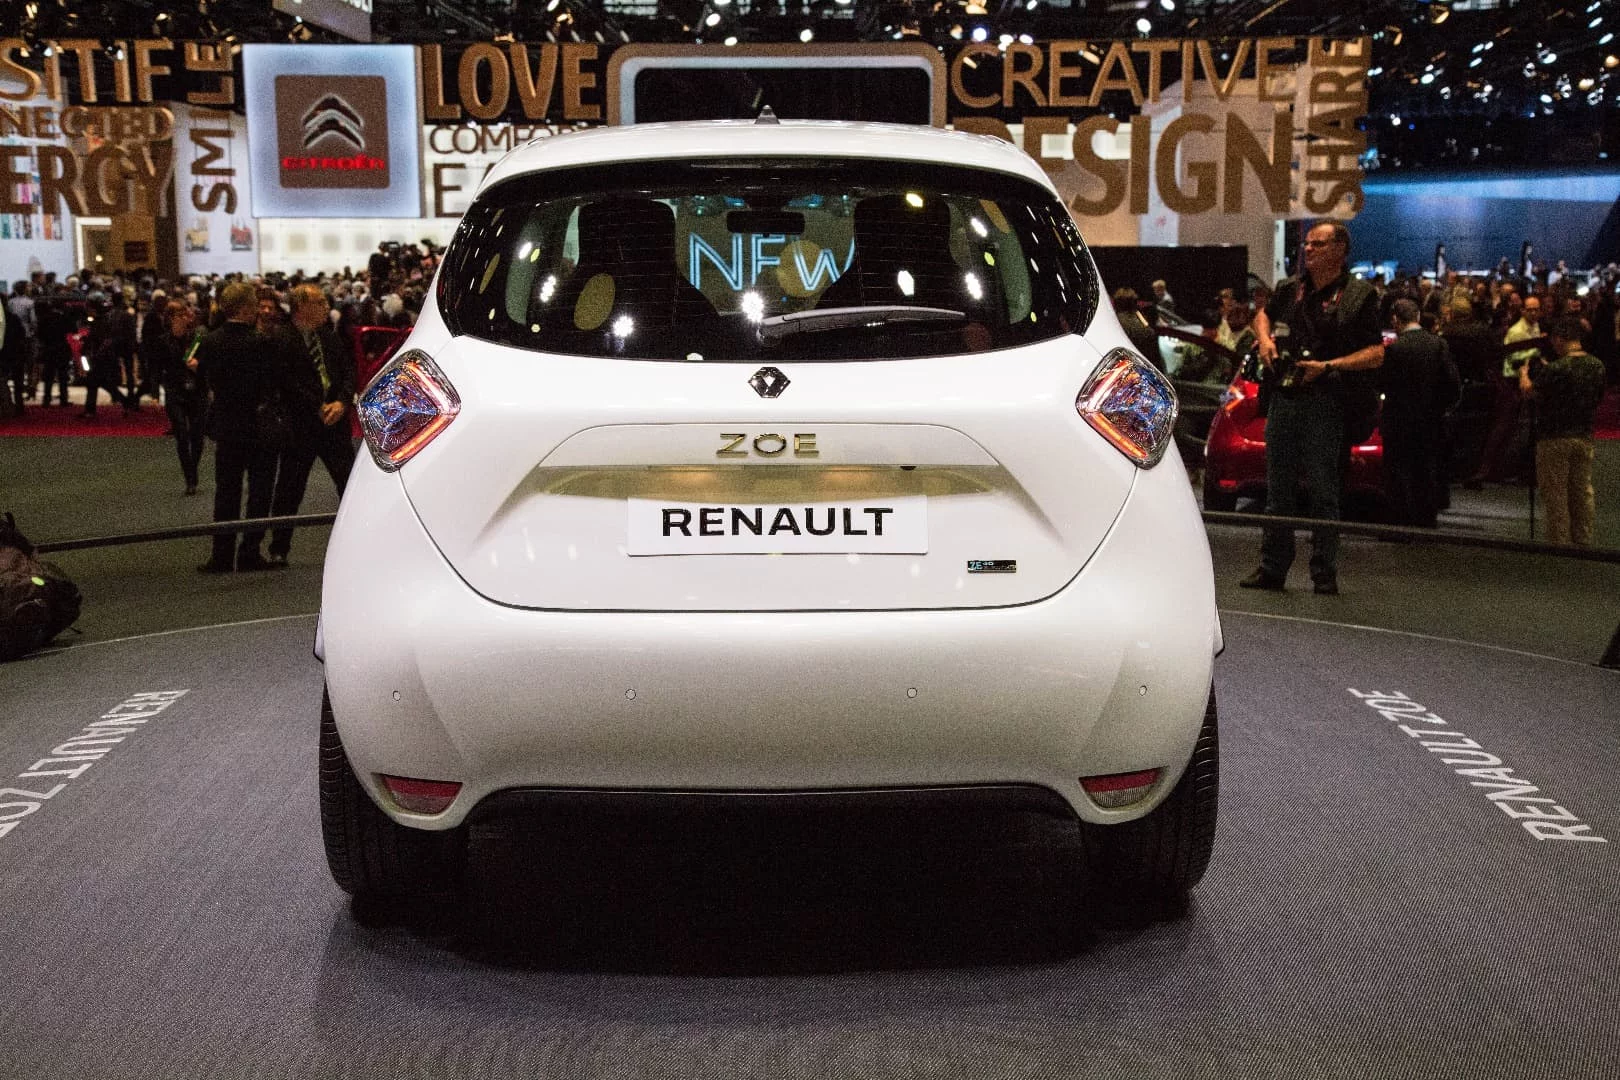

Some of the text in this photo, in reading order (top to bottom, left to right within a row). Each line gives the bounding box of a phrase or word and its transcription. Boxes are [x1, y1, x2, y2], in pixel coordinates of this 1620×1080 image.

[421, 43, 602, 120] LOVE
[951, 38, 1298, 107] CREATIVE
[184, 40, 238, 214] SMILE
[952, 115, 1293, 216] ESIGN
[1306, 36, 1372, 214] SHARE
[716, 432, 819, 458] ZOE
[661, 508, 893, 537] RENAULT
[18, 688, 191, 779] RENAULT
[1347, 688, 1608, 843] RENAULT ZOE
